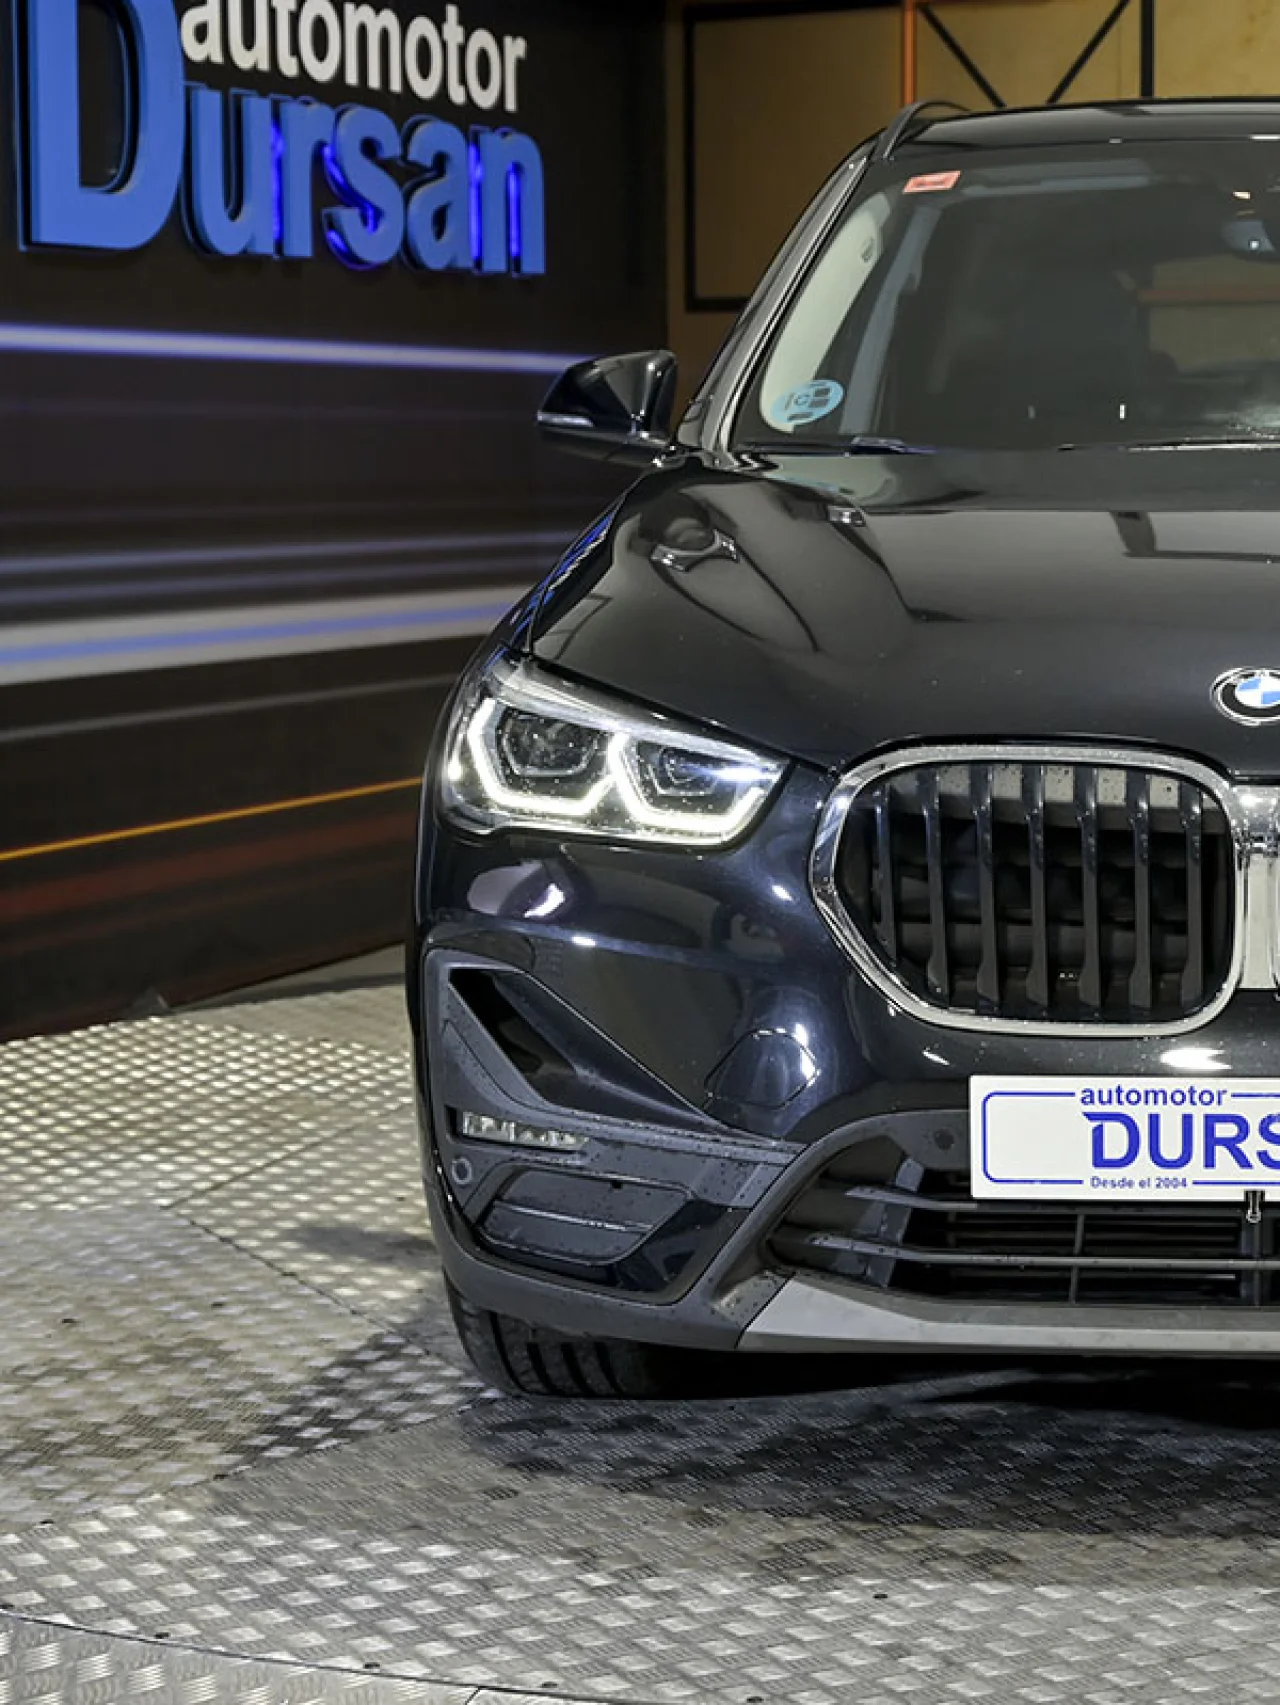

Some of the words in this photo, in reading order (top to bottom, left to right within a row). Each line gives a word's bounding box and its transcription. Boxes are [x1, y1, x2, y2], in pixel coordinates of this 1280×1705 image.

[181, 0, 527, 112] automotor
[20, 0, 545, 273] Dursan
[1080, 1084, 1228, 1106] automotor
[1090, 1176, 1135, 1189] Desde
[1138, 1177, 1151, 1189] el
[1155, 1177, 1188, 1189] 2004
